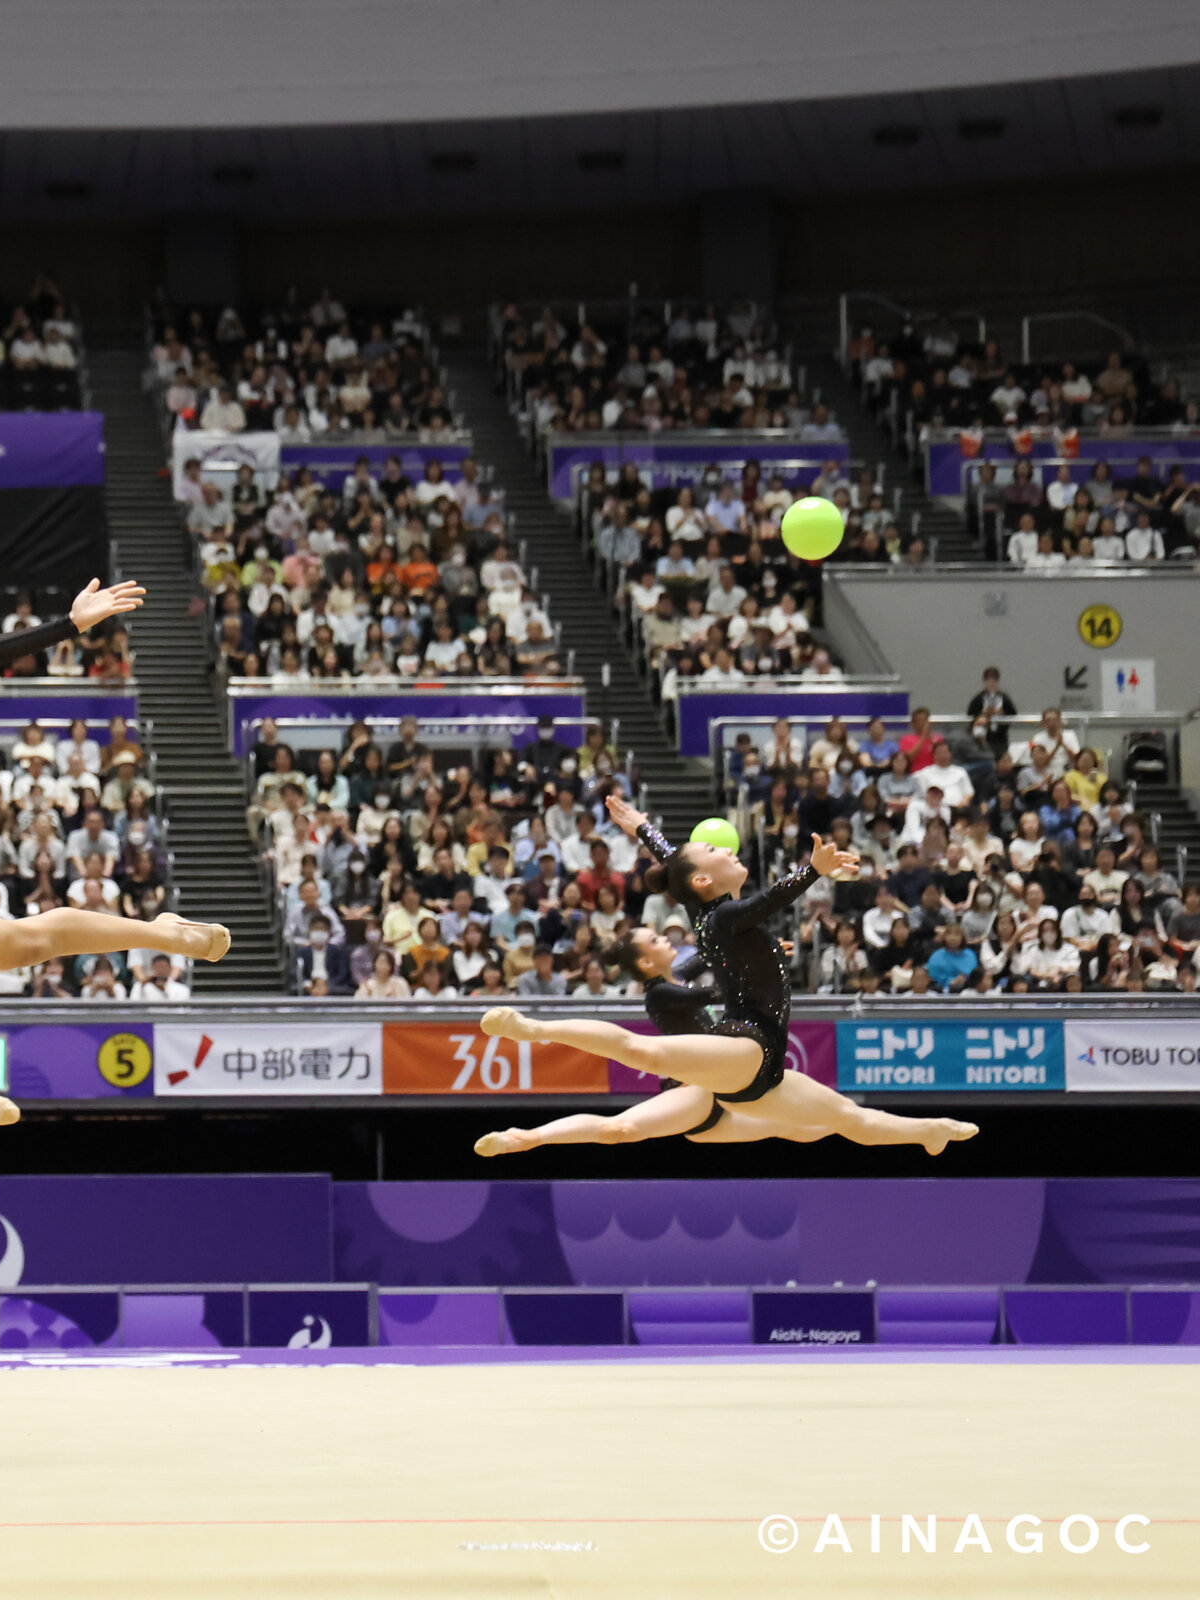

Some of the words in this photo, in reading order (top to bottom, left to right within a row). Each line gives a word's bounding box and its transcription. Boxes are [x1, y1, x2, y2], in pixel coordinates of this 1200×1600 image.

[1086, 617, 1113, 639] 14
[855, 1027, 935, 1060] ニトリ
[965, 1027, 1046, 1060] ニトリ
[1100, 1047, 1160, 1066] TOBU
[1166, 1047, 1200, 1066] TO
[116, 1048, 135, 1079] 5
[223, 1047, 371, 1081] 中部電力
[449, 1034, 550, 1090] 361
[855, 1065, 936, 1085] NITORI
[965, 1065, 1047, 1085] NITORI
[769, 1328, 861, 1344] Aichi-Nagoya
